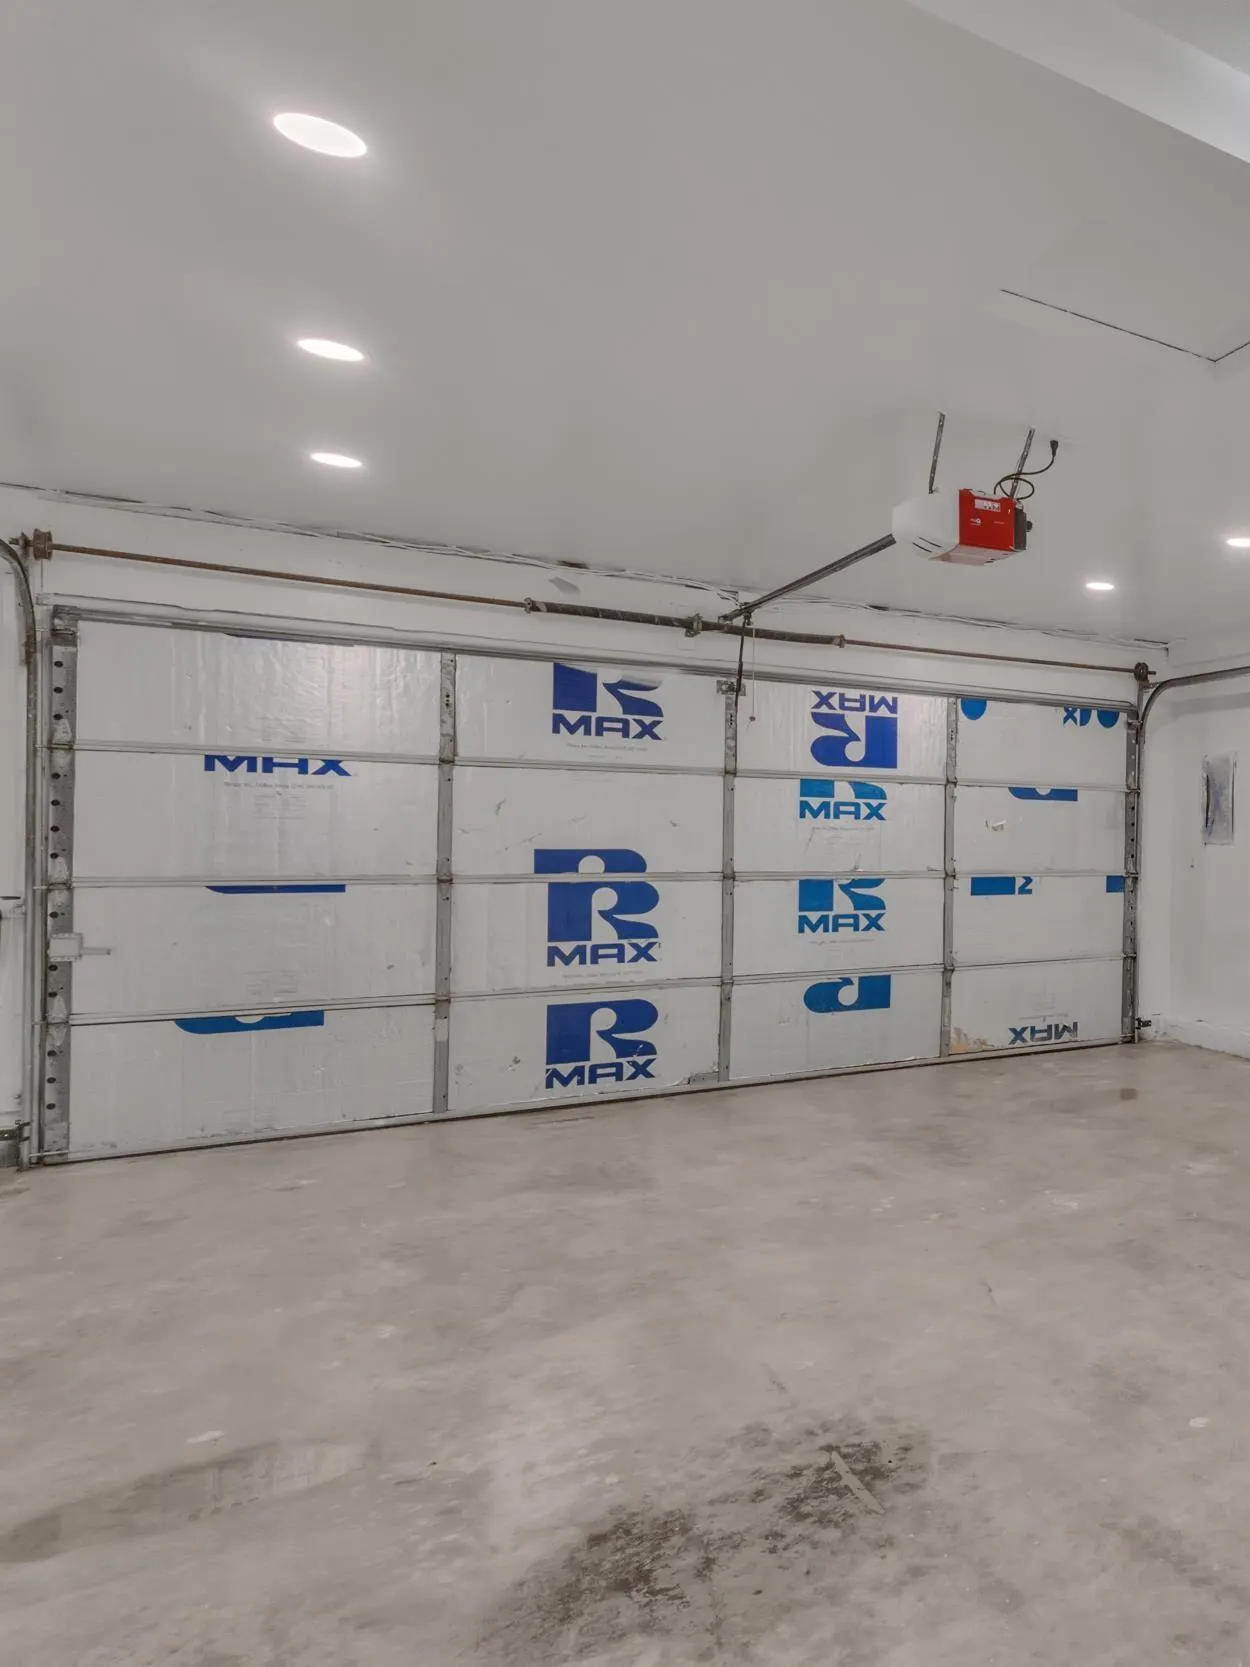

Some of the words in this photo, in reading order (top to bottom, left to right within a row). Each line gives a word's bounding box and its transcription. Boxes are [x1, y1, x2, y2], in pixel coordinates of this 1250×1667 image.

[552, 713, 664, 740] MAX
[799, 801, 887, 821] MAX
[548, 882, 660, 942] R
[798, 912, 885, 933] MAX
[547, 941, 658, 966] MAX
[546, 999, 658, 1064] R
[545, 1058, 656, 1089] MAX
